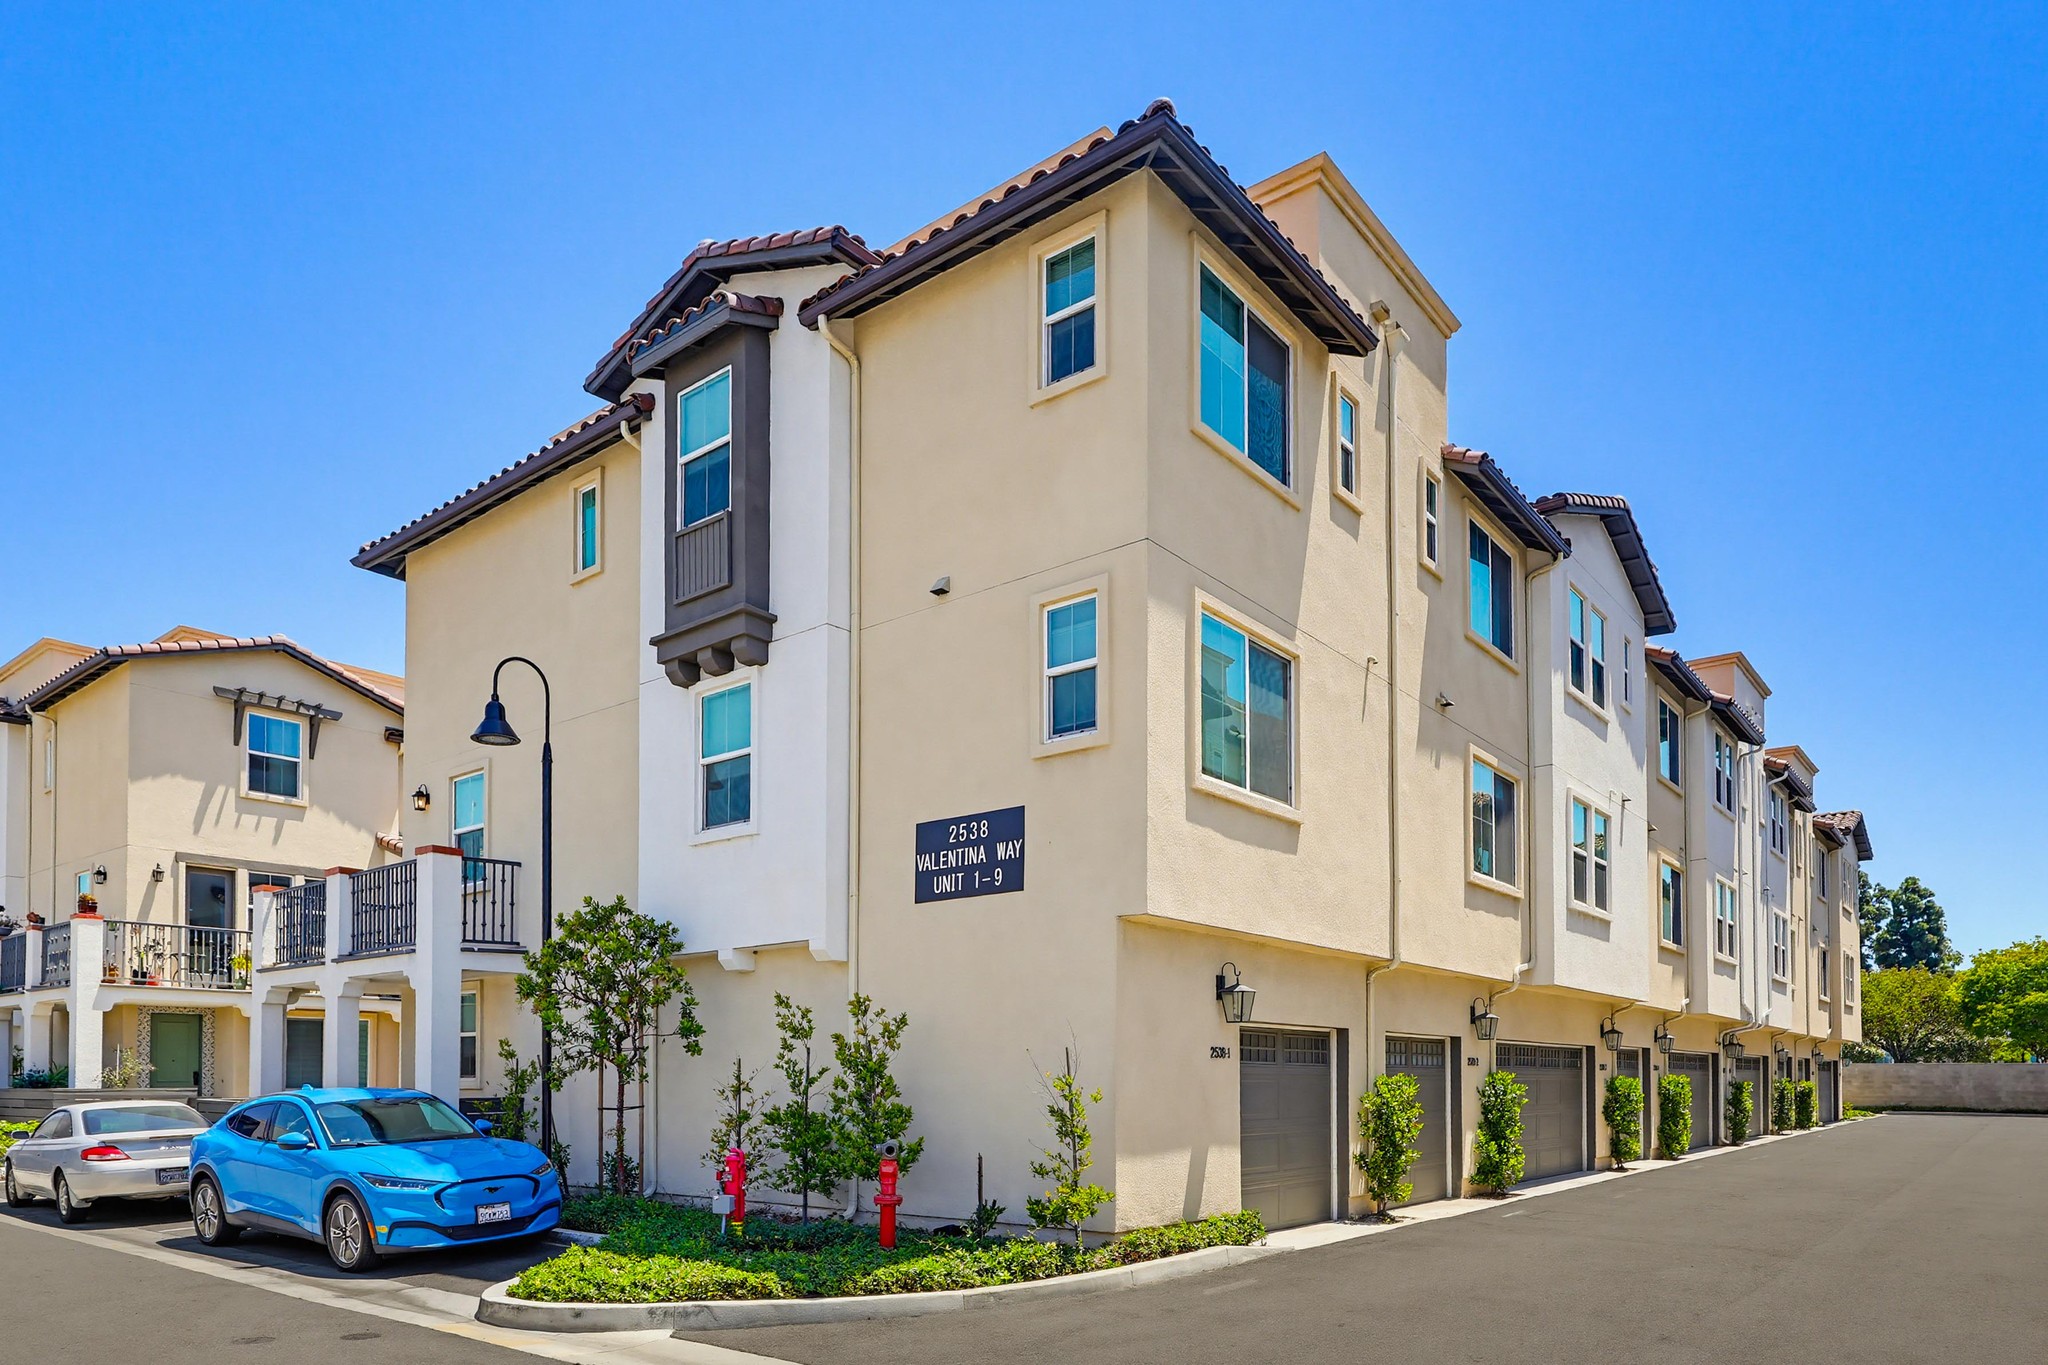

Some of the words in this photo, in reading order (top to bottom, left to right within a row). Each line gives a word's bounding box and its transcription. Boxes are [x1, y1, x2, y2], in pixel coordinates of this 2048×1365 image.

[949, 820, 988, 843] 2538
[917, 845, 986, 872] VALENTINA
[997, 839, 1023, 861] WAY
[934, 873, 964, 894] UNIT
[974, 868, 1003, 889] 1-9
